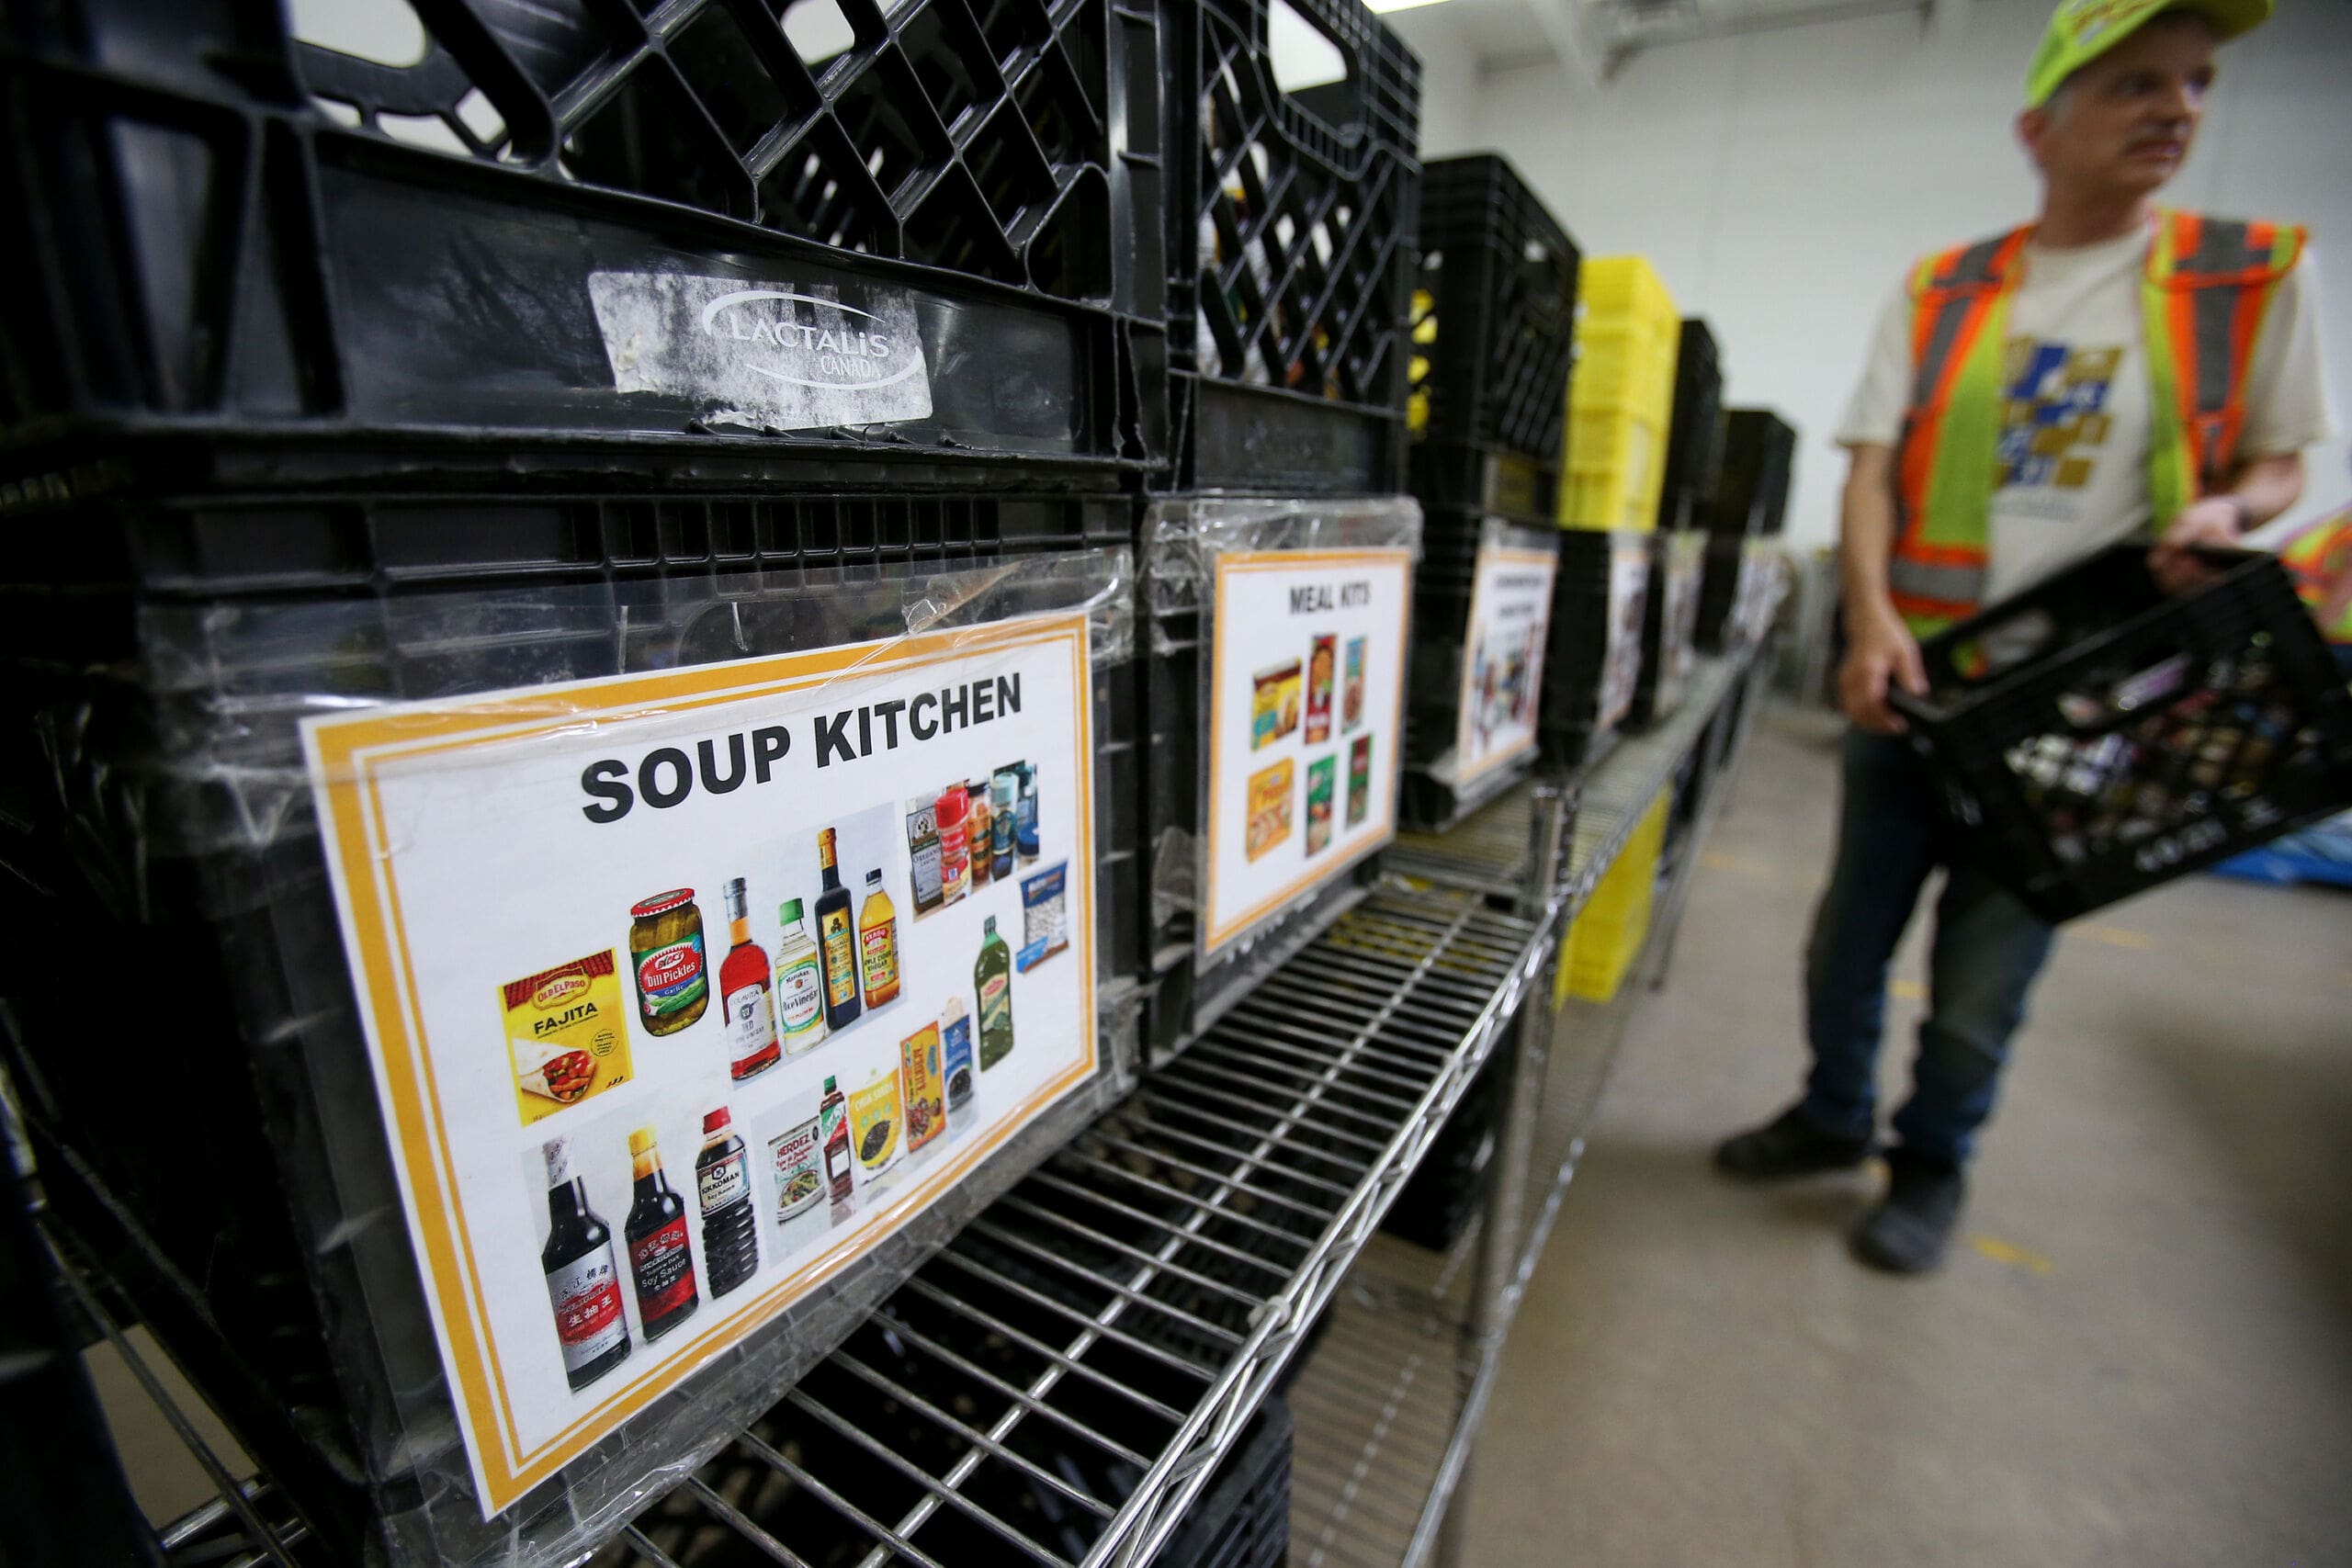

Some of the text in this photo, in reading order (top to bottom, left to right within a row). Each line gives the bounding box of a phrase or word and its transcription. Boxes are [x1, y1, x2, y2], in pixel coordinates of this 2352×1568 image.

[820, 355, 882, 378] CANADA
[1288, 585, 1335, 615] MEAL
[582, 671, 1022, 824] SOUP KITCHEN
[648, 961, 695, 988] Dill Pickles
[533, 1002, 598, 1035] FAJITA
[776, 1134, 810, 1159] HERDEZ
[701, 1171, 740, 1195] KIKKOMAN
[641, 1275, 659, 1288] Soy
